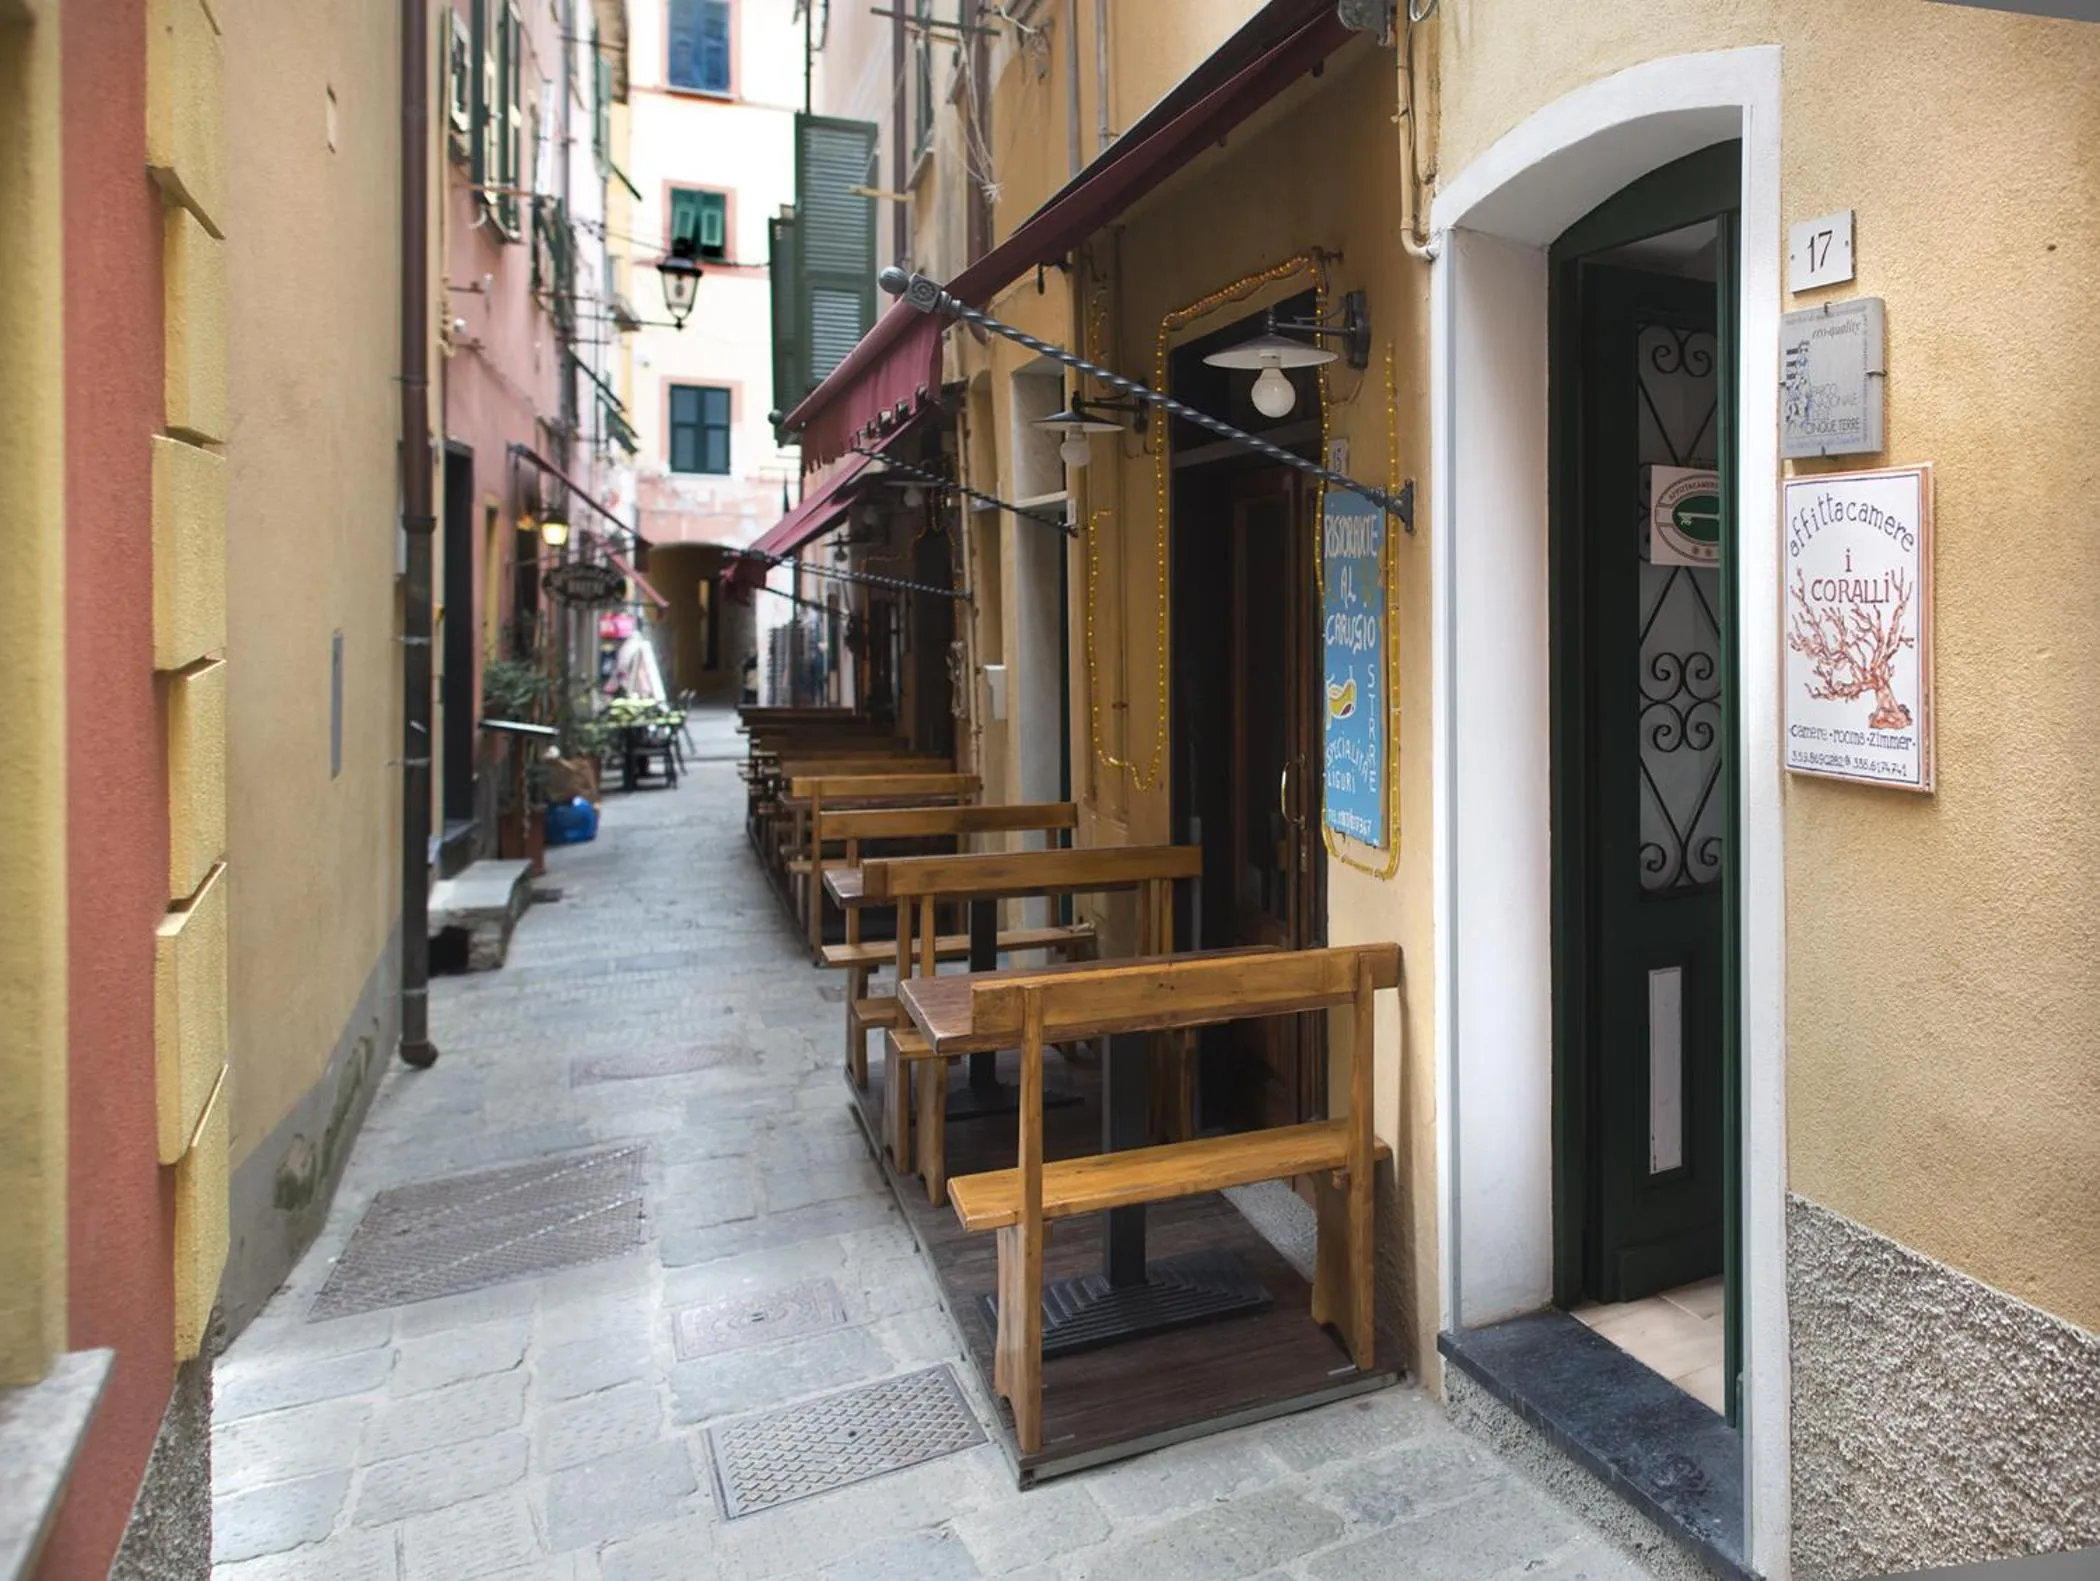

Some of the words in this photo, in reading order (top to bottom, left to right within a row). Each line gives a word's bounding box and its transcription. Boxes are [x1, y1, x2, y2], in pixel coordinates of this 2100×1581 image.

[1807, 229, 1833, 273] 17
[1324, 515, 1377, 558] RISTORANTE
[1790, 491, 1914, 557] affittacamere
[1845, 547, 1852, 572] i
[1340, 565, 1356, 609] AL
